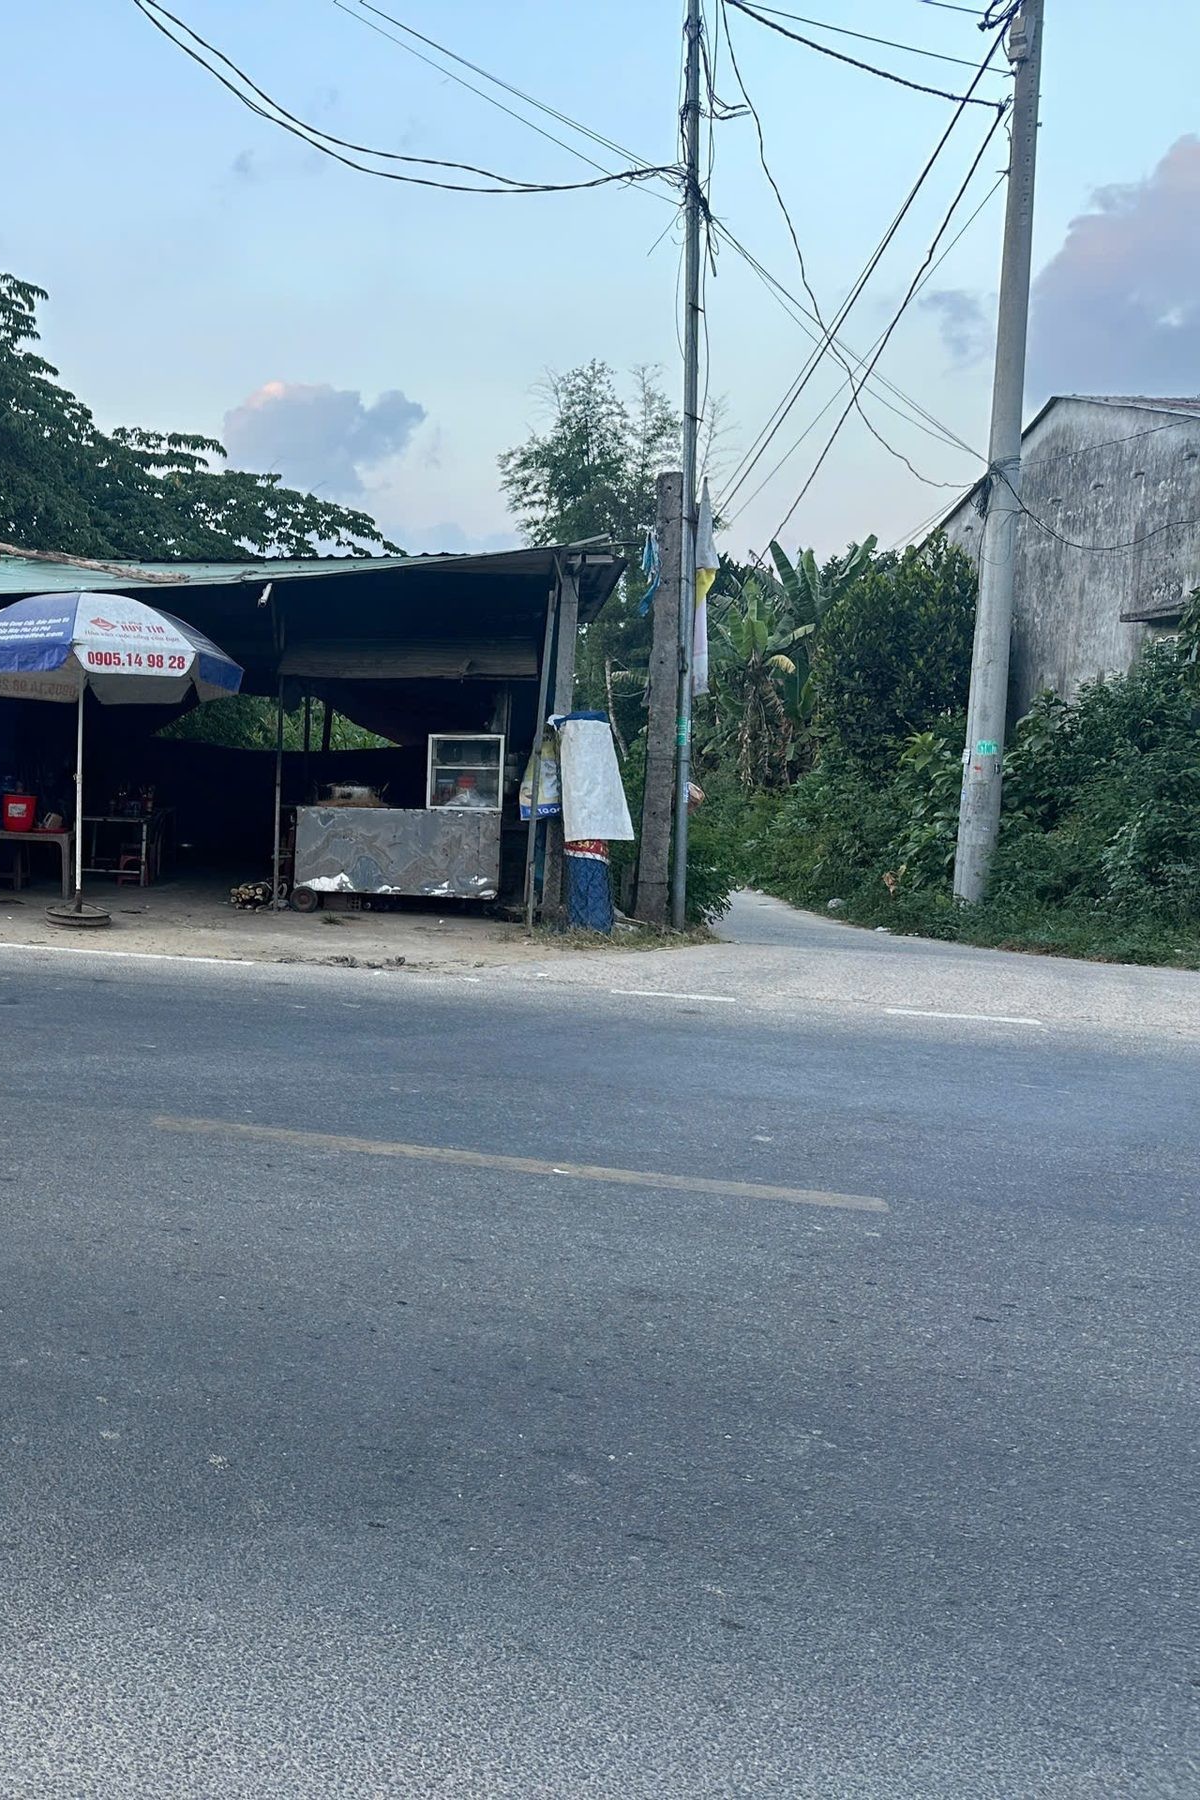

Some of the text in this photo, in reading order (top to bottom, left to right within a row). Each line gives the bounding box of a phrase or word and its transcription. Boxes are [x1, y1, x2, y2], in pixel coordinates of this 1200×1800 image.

[121, 623, 142, 633] HUY
[87, 651, 186, 670] 0905.14 98 28
